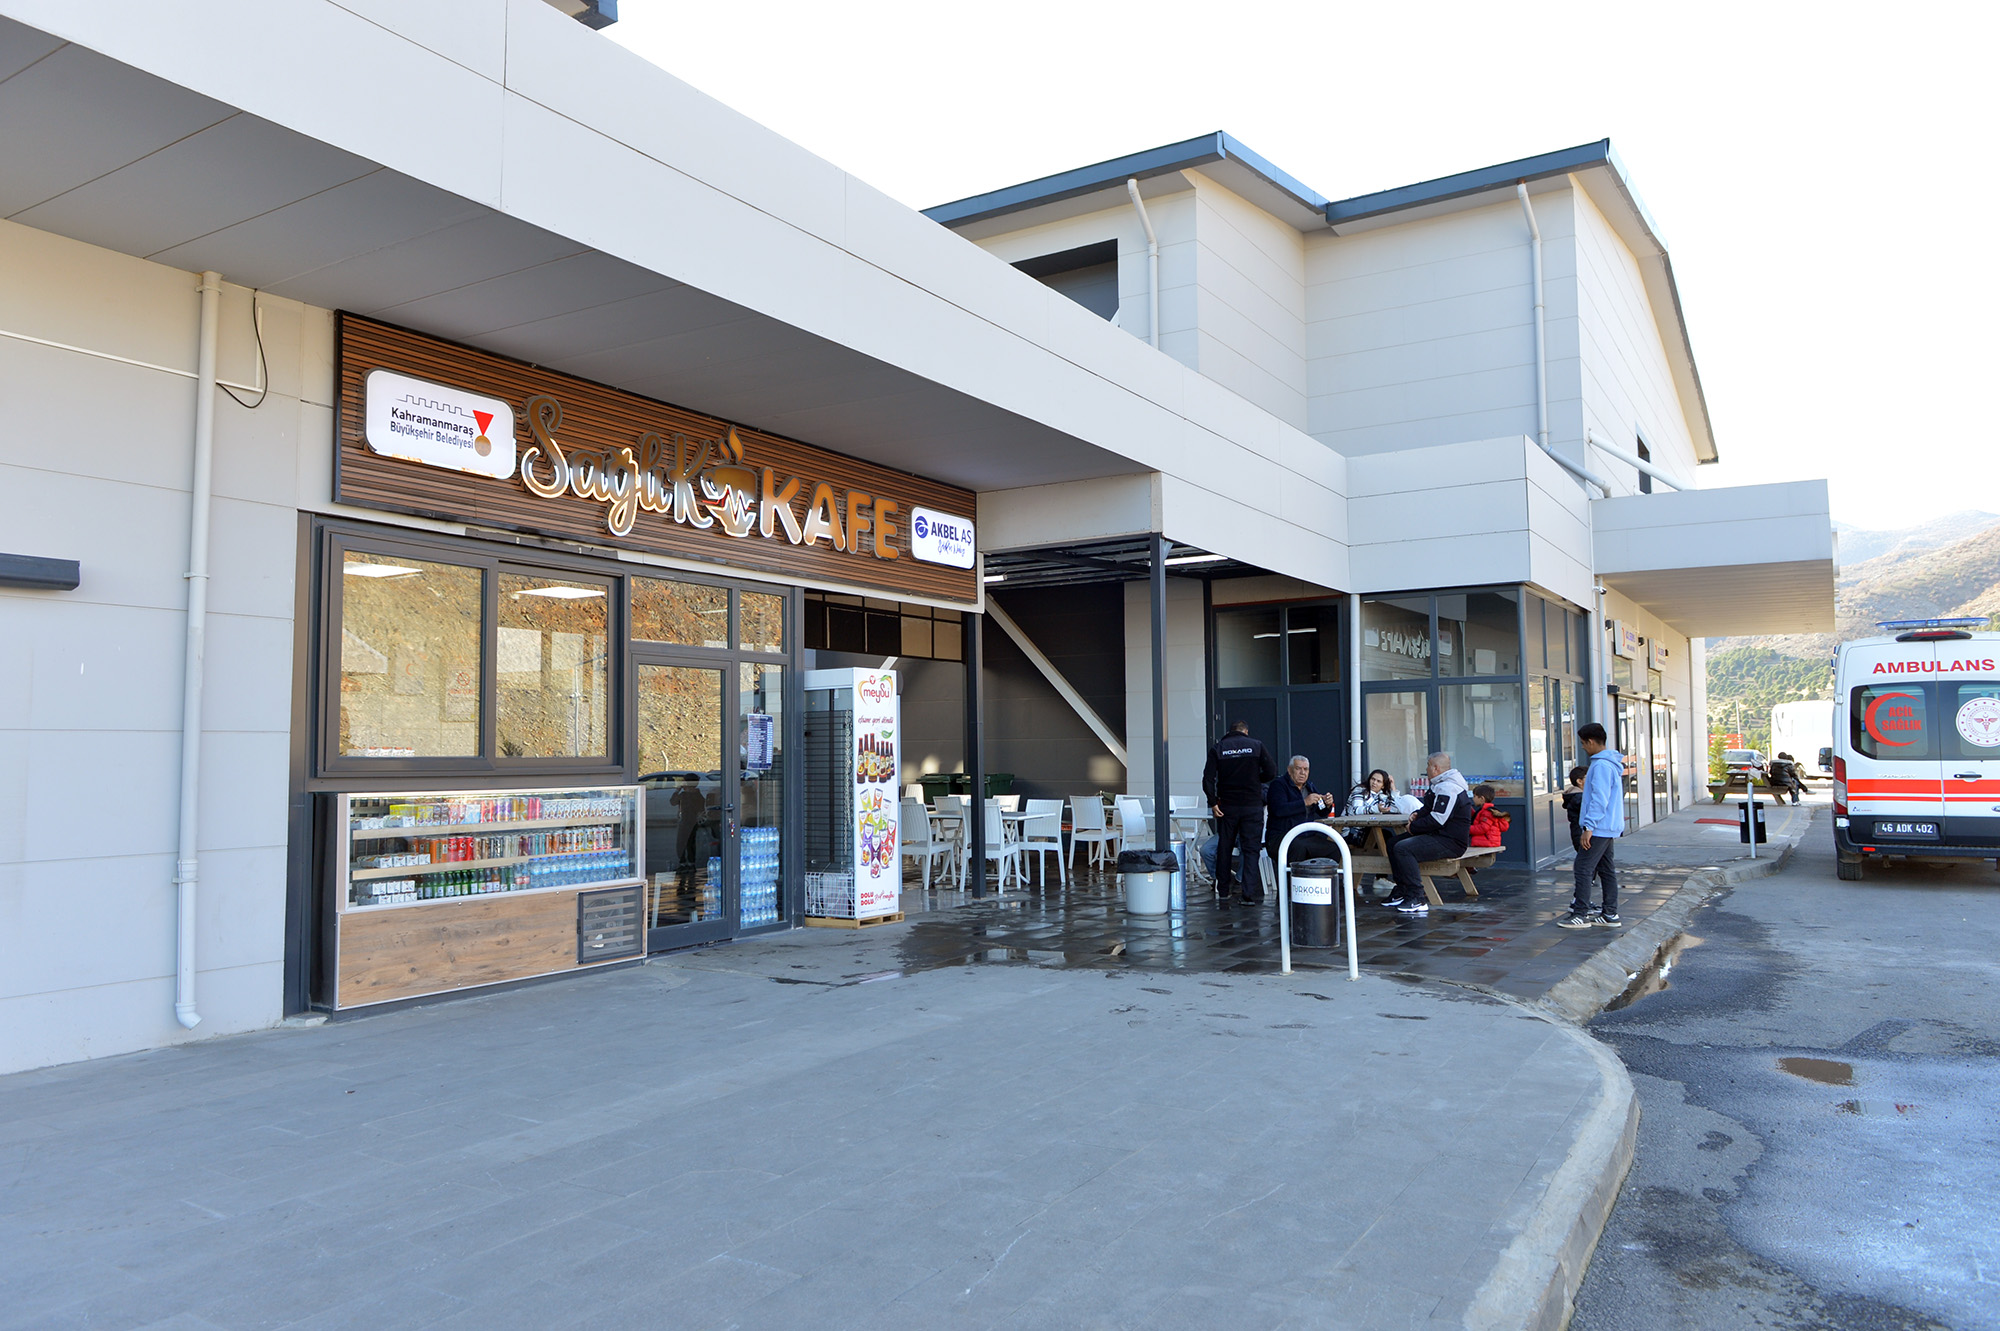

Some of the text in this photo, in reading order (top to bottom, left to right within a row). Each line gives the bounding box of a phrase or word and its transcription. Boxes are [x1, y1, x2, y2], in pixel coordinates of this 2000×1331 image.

[391, 407, 474, 438] Kahramanmaraş
[390, 421, 474, 449] Büyükşehir Belediyesi
[760, 466, 899, 561] KAFE
[931, 521, 972, 546] AKBEL AŞ
[1872, 659, 1995, 674] AMBULANS
[1888, 704, 1914, 717] ACİL
[1881, 718, 1922, 731] SAĞLIK
[1881, 823, 1933, 833] 46 ADK 402
